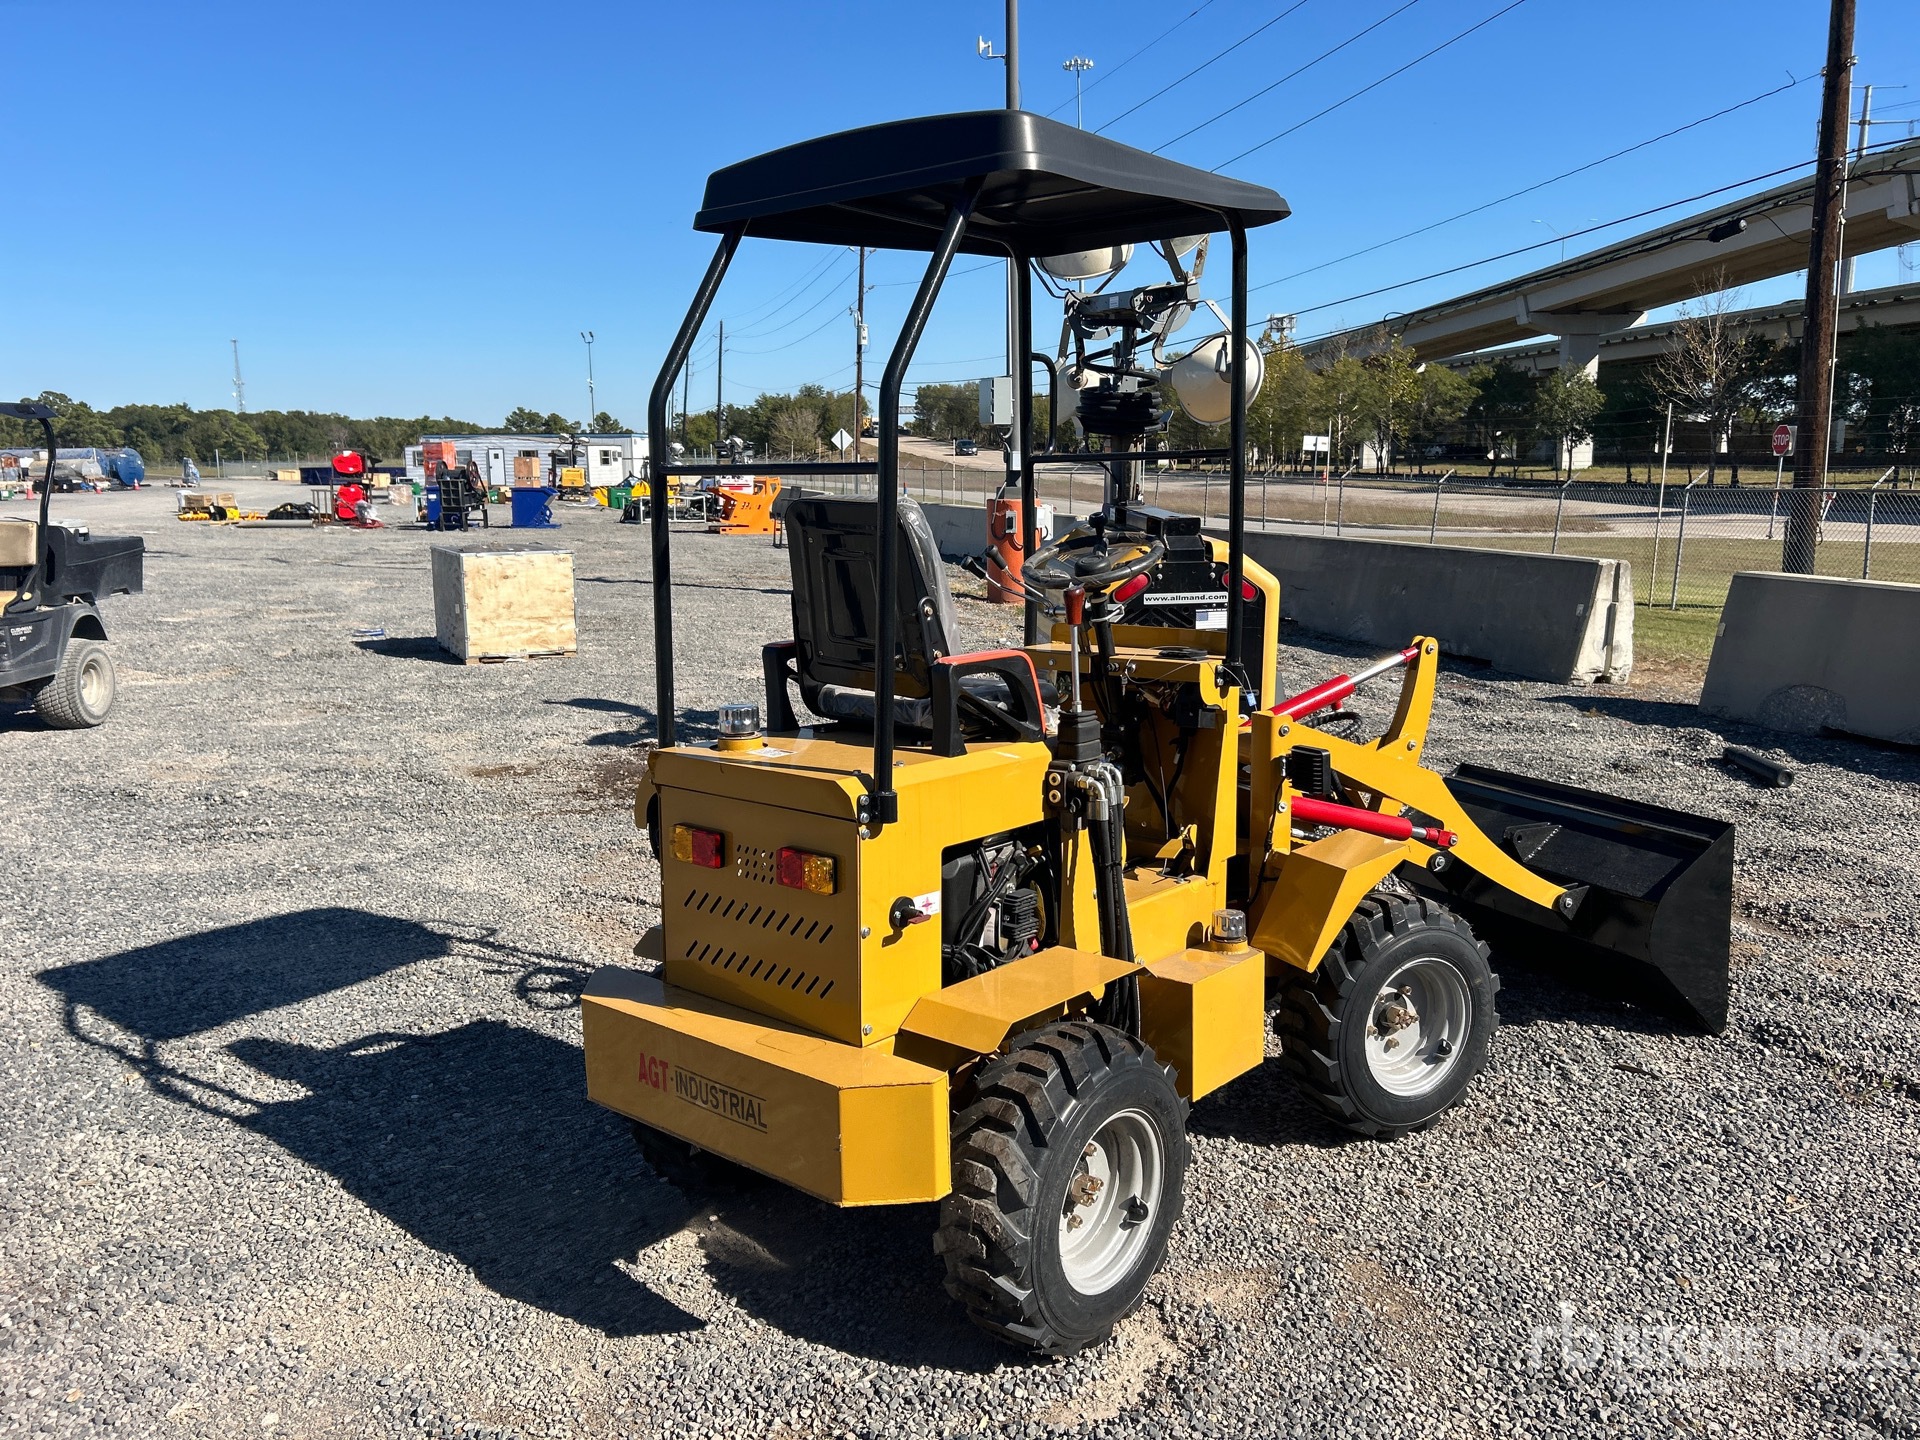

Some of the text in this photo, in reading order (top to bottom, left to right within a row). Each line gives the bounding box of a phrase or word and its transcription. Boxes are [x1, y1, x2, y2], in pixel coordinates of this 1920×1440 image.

[1773, 434, 1790, 446] STOP
[1144, 594, 1227, 602] www.allmand.com
[638, 1052, 768, 1129] AGT INDUSTRIAL
